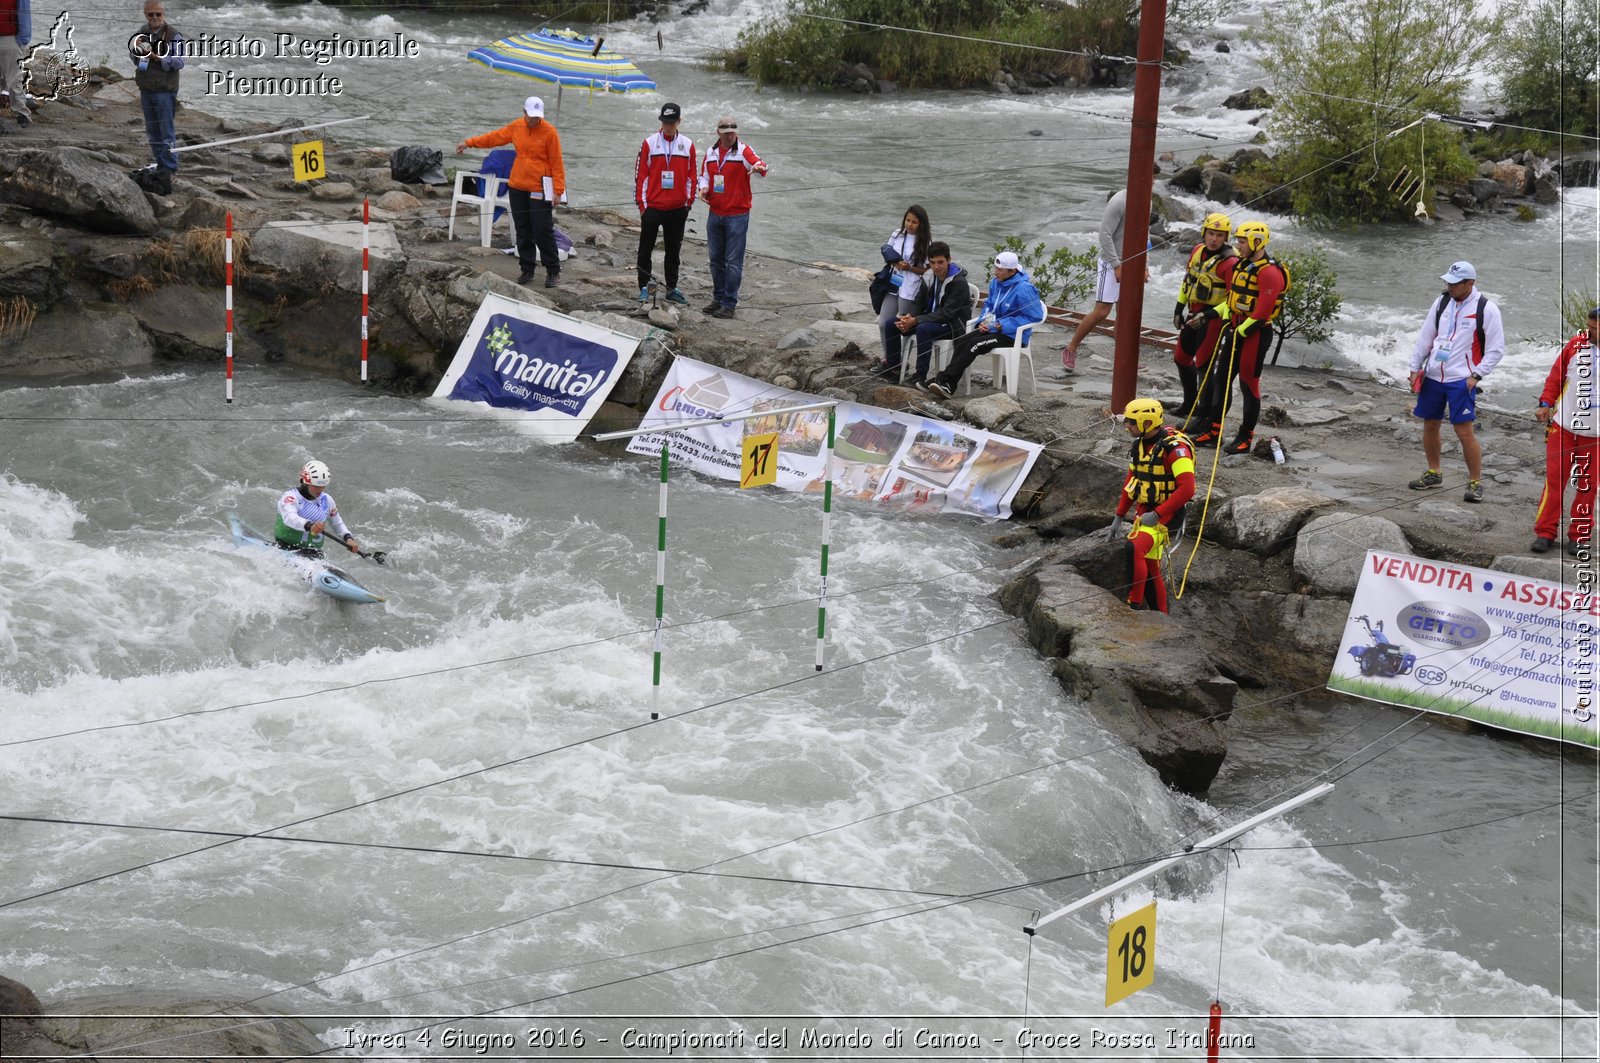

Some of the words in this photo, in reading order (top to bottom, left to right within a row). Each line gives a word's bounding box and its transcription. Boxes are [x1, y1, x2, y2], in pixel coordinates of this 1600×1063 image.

[300, 149, 319, 174] 16
[494, 348, 605, 397] manital
[502, 380, 533, 400] facility
[638, 435, 650, 444] Tel.
[749, 443, 772, 477] 17
[1372, 555, 1473, 592] VENDITA
[1412, 605, 1445, 617] MACCHINE
[1408, 614, 1477, 639] GETTO
[1502, 625, 1518, 639] Via
[1521, 629, 1553, 648] Torino,
[1413, 632, 1462, 647] GIARDINAGGIO
[1520, 648, 1536, 661] Tel.
[1418, 668, 1444, 682] BCS
[1450, 679, 1493, 696] HITACHI
[1510, 692, 1557, 710] Husqvarna
[1118, 925, 1147, 984] 18
